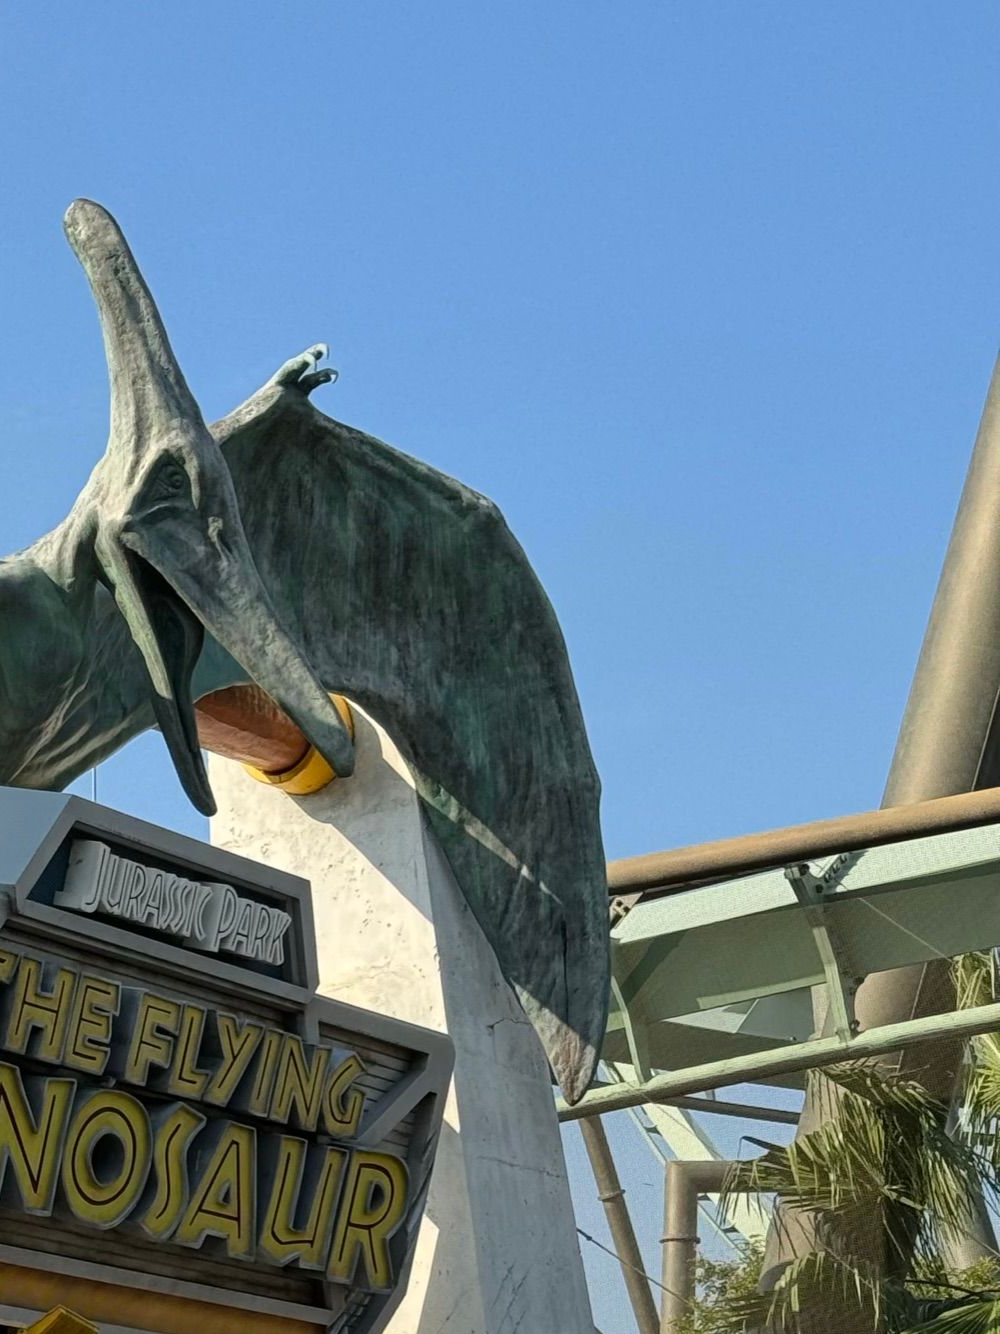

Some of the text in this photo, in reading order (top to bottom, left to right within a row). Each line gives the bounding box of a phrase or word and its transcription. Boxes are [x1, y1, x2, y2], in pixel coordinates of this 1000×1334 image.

[80, 845, 292, 966] JURASSIC PARK
[125, 991, 368, 1138] FLYING
